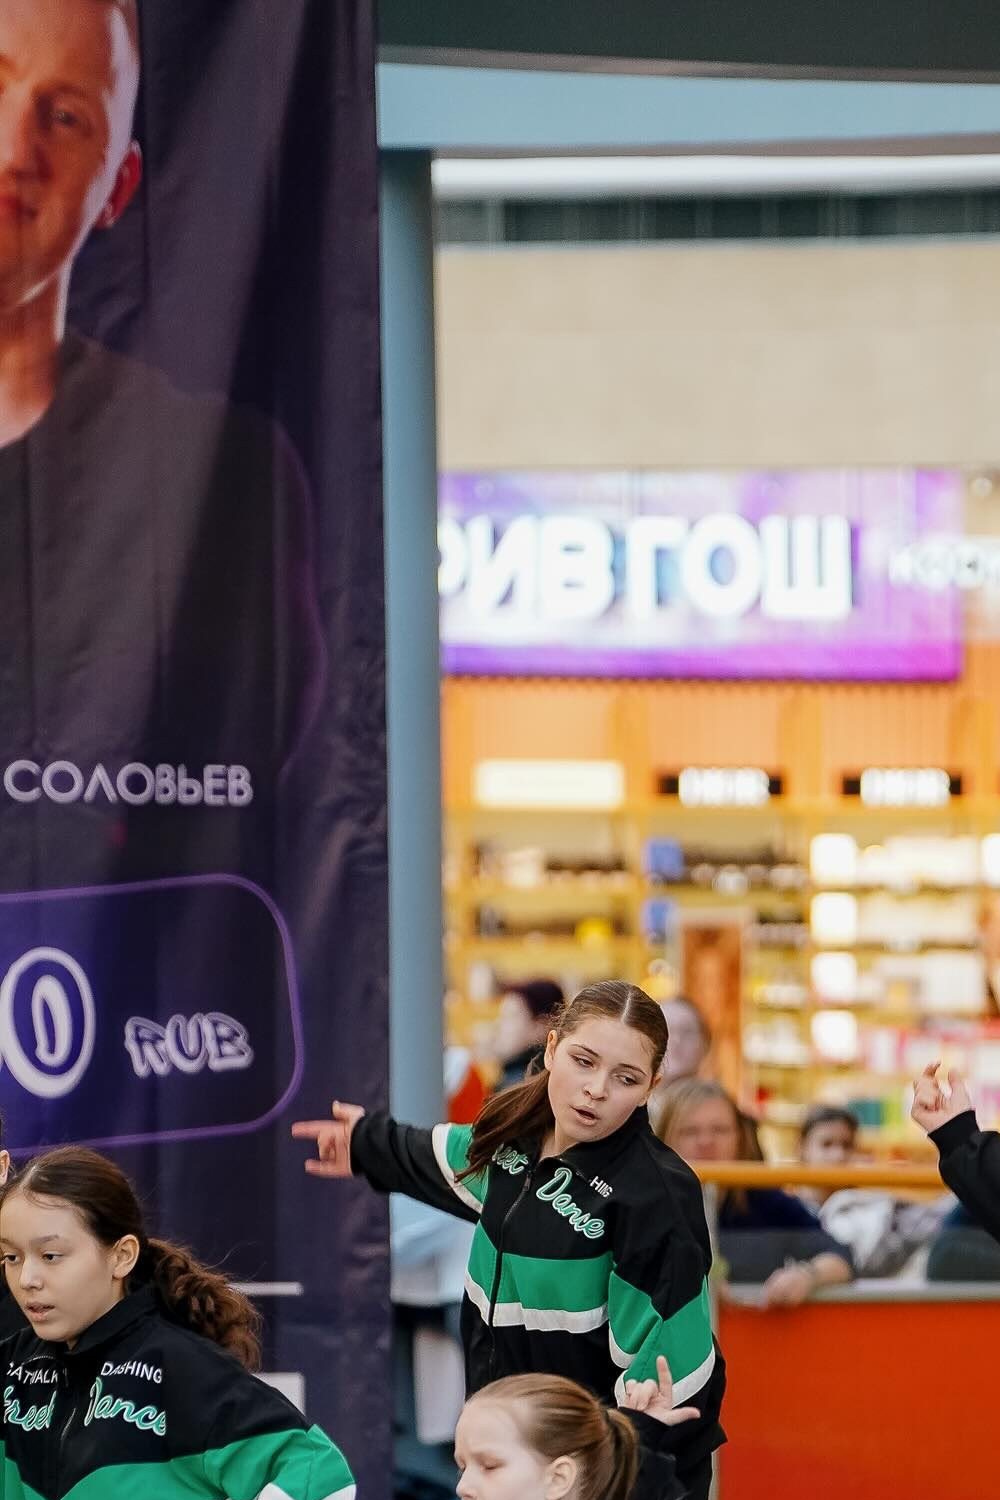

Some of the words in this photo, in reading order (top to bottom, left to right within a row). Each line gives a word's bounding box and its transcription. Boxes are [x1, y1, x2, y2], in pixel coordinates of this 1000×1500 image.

[622, 511, 852, 622] ГОШ
[4, 759, 254, 807] СОЛОВЬЕВ
[125, 1012, 254, 1078] RUB
[535, 1167, 605, 1239] Dance
